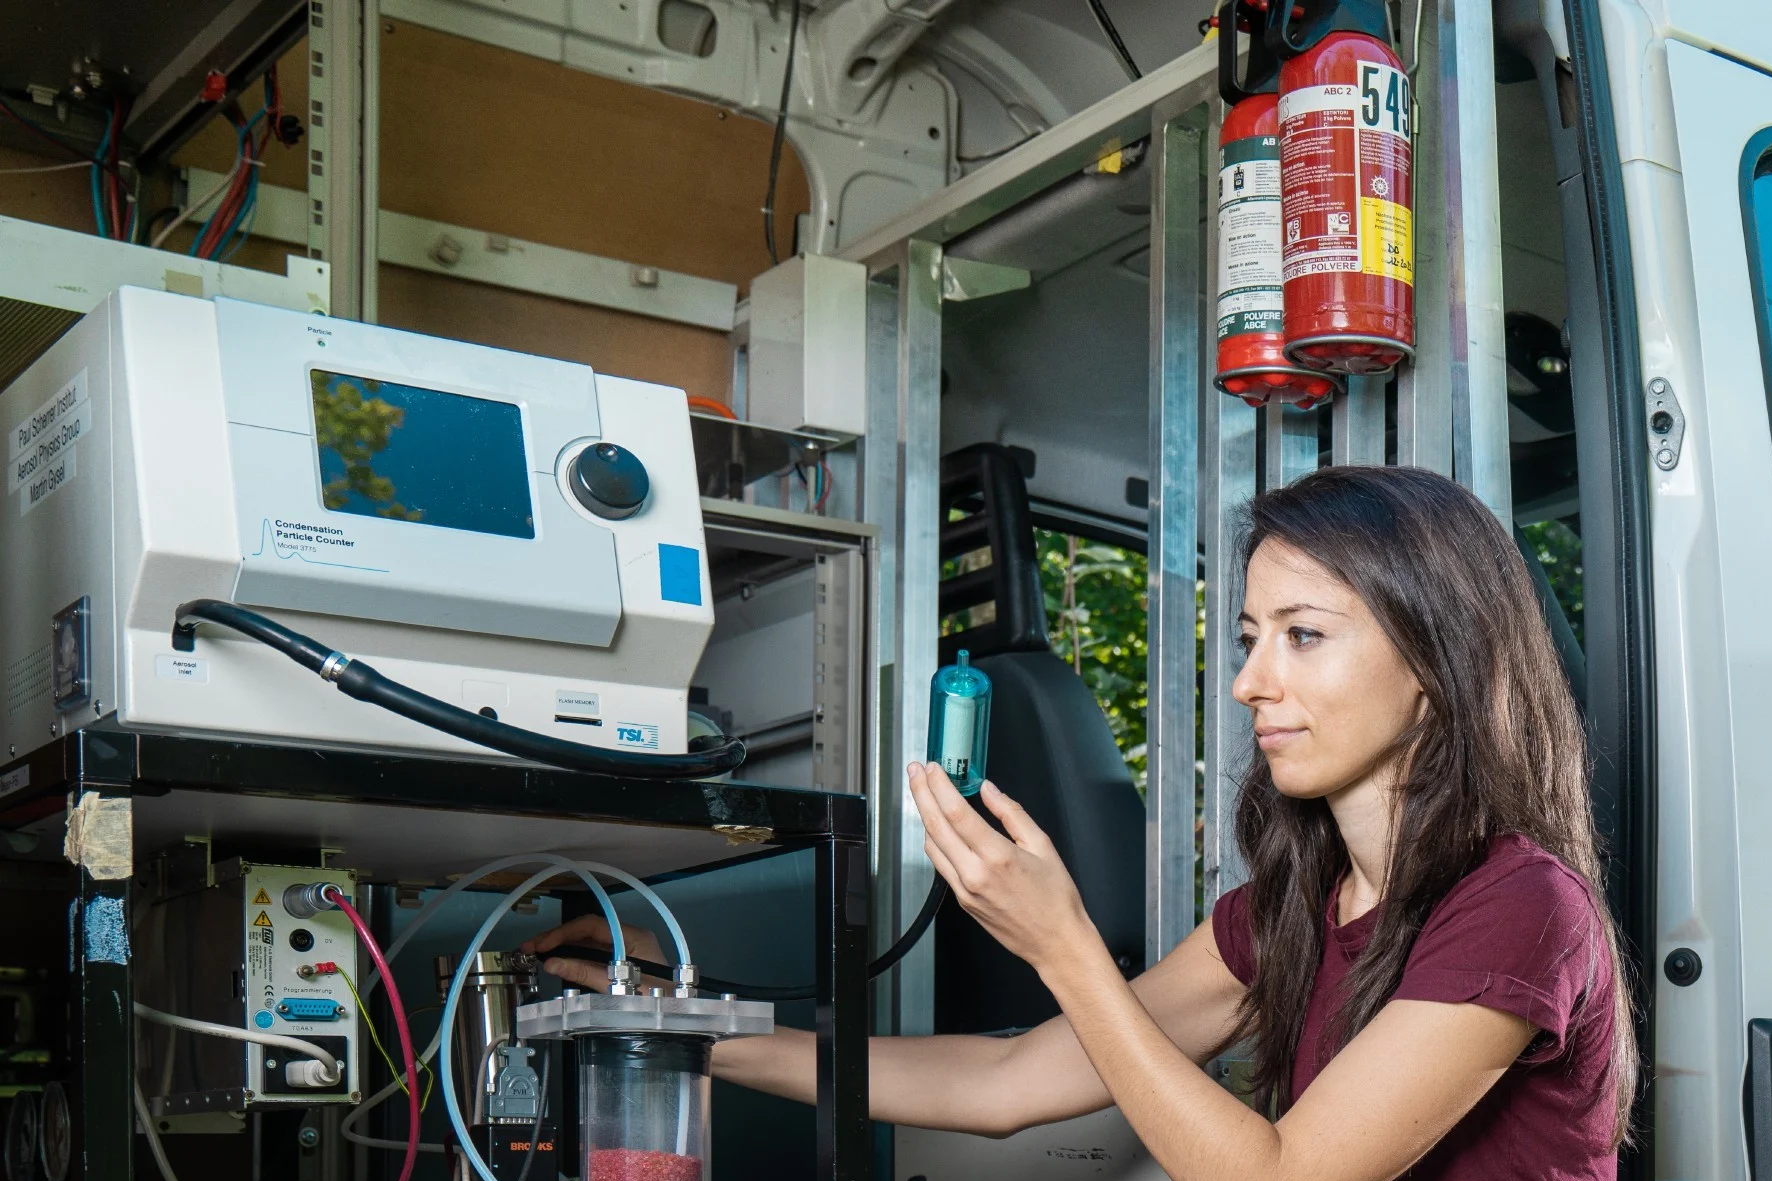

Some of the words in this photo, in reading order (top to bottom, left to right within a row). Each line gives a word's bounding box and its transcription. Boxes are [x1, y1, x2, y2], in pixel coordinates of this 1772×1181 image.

[1323, 87, 1343, 97] ABC
[1346, 87, 1353, 97] 2
[1361, 64, 1411, 139] 549
[1339, 213, 1349, 224] C
[1311, 261, 1357, 273] POLVERE
[1244, 312, 1281, 323] POLVERE
[306, 325, 333, 336] Particle
[1244, 320, 1267, 330] ABCE
[18, 421, 32, 448] Paul
[18, 449, 38, 483] Aerosol
[39, 432, 61, 465] Physics
[61, 418, 81, 446] Group
[30, 476, 48, 505] Martin
[275, 519, 343, 536] Condensation
[276, 530, 314, 542] Particle
[315, 535, 355, 548] Counter
[277, 542, 299, 550] Model
[283, 986, 333, 996] Programmierung
[510, 1141, 554, 1151] BROKS
